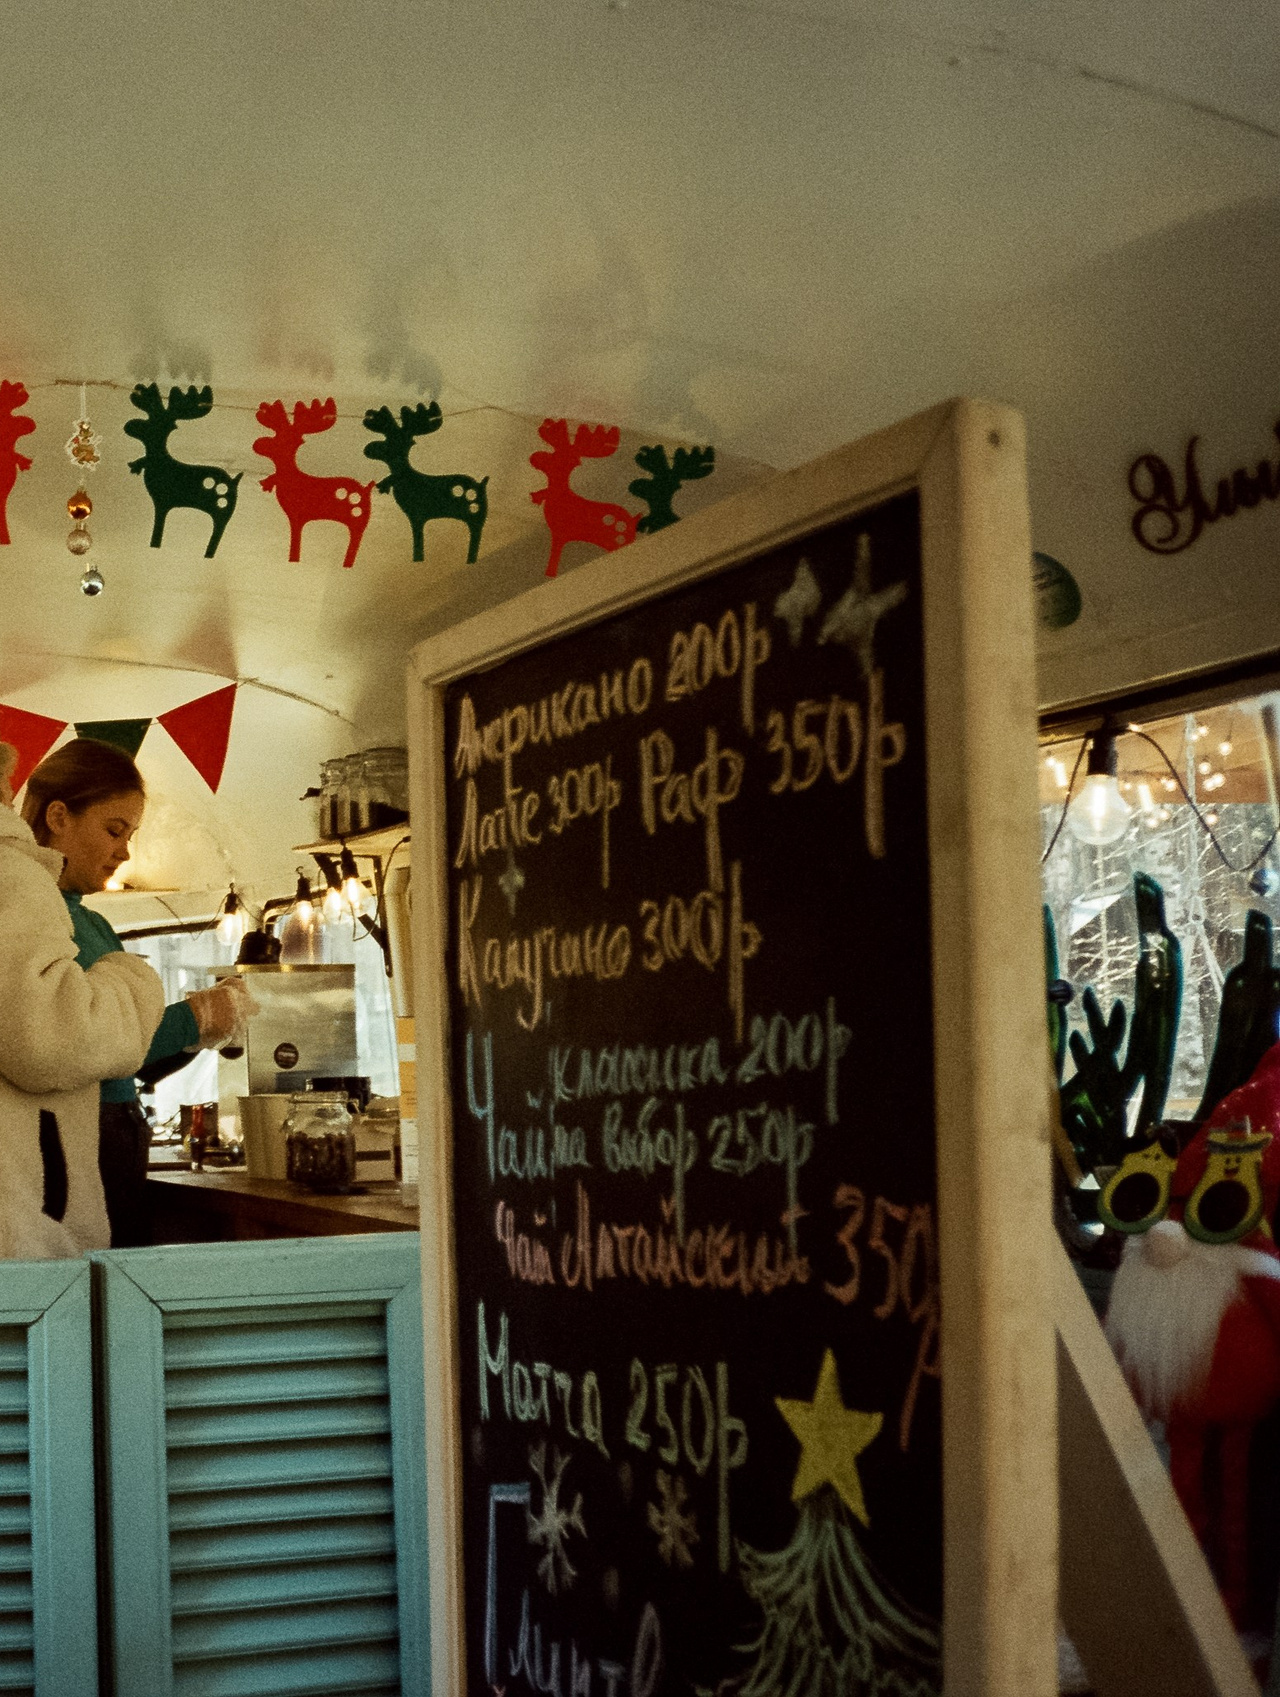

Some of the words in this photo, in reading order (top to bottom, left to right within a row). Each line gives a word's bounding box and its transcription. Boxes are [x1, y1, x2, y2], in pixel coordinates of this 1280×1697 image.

[666, 602, 772, 736] 200р
[548, 754, 621, 890] 300р
[639, 725, 746, 893] Раф
[766, 667, 908, 860] 350р
[639, 859, 763, 1044] 300р
[736, 995, 854, 1126] 200р
[709, 1101, 817, 1255] 250р
[625, 1356, 750, 1573] 250р
